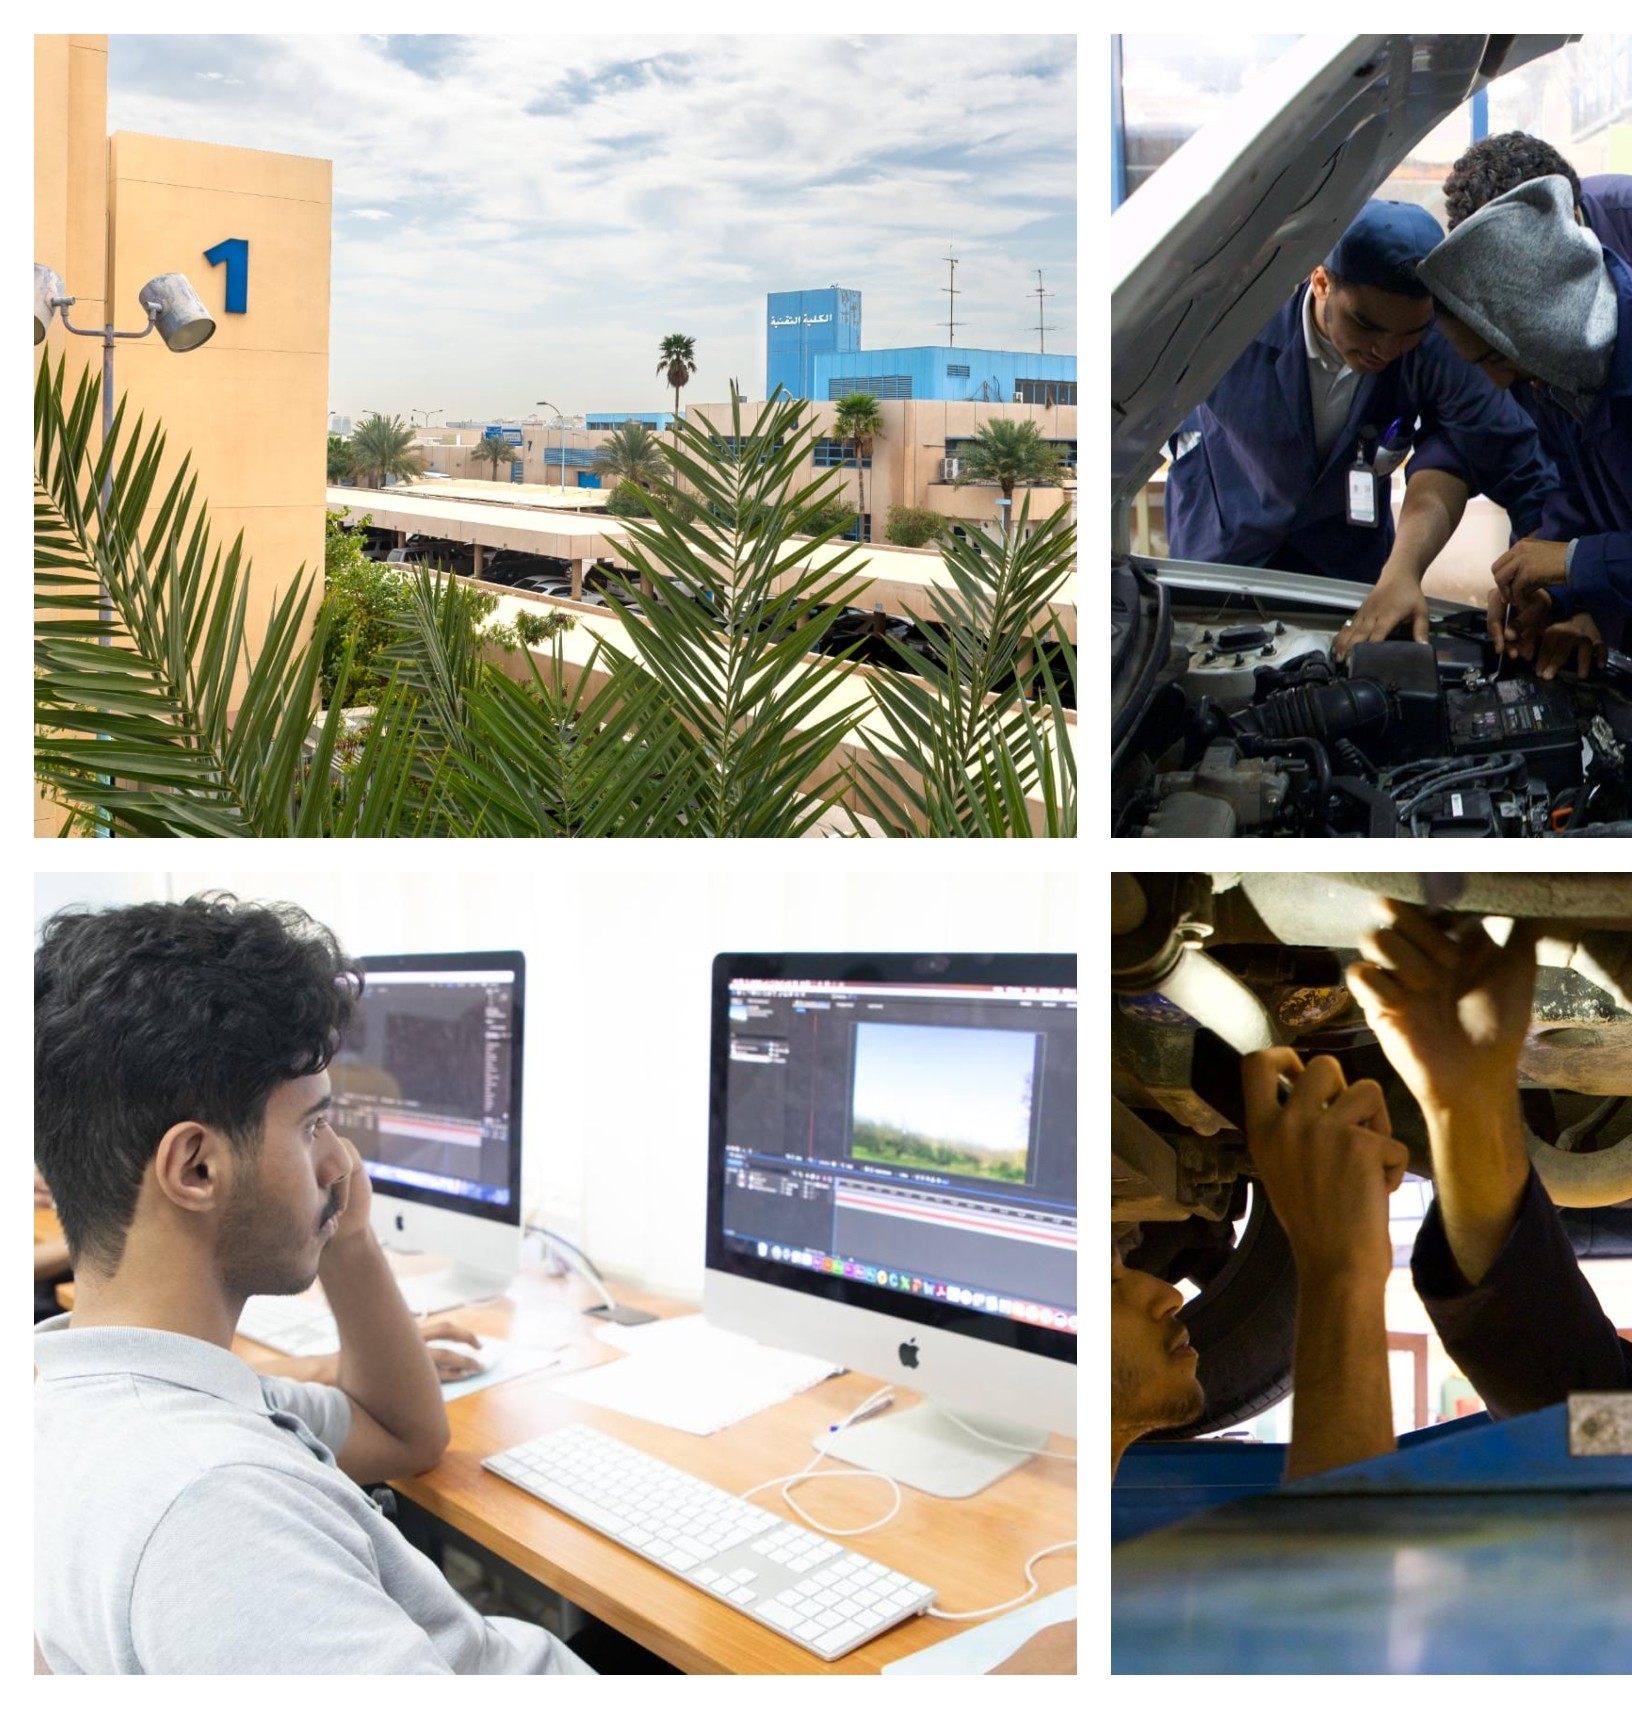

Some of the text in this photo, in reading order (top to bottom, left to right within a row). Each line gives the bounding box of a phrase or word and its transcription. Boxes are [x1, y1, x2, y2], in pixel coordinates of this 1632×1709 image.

[203, 238, 248, 313] 1
[770, 313, 833, 329] الكلية التقنية
